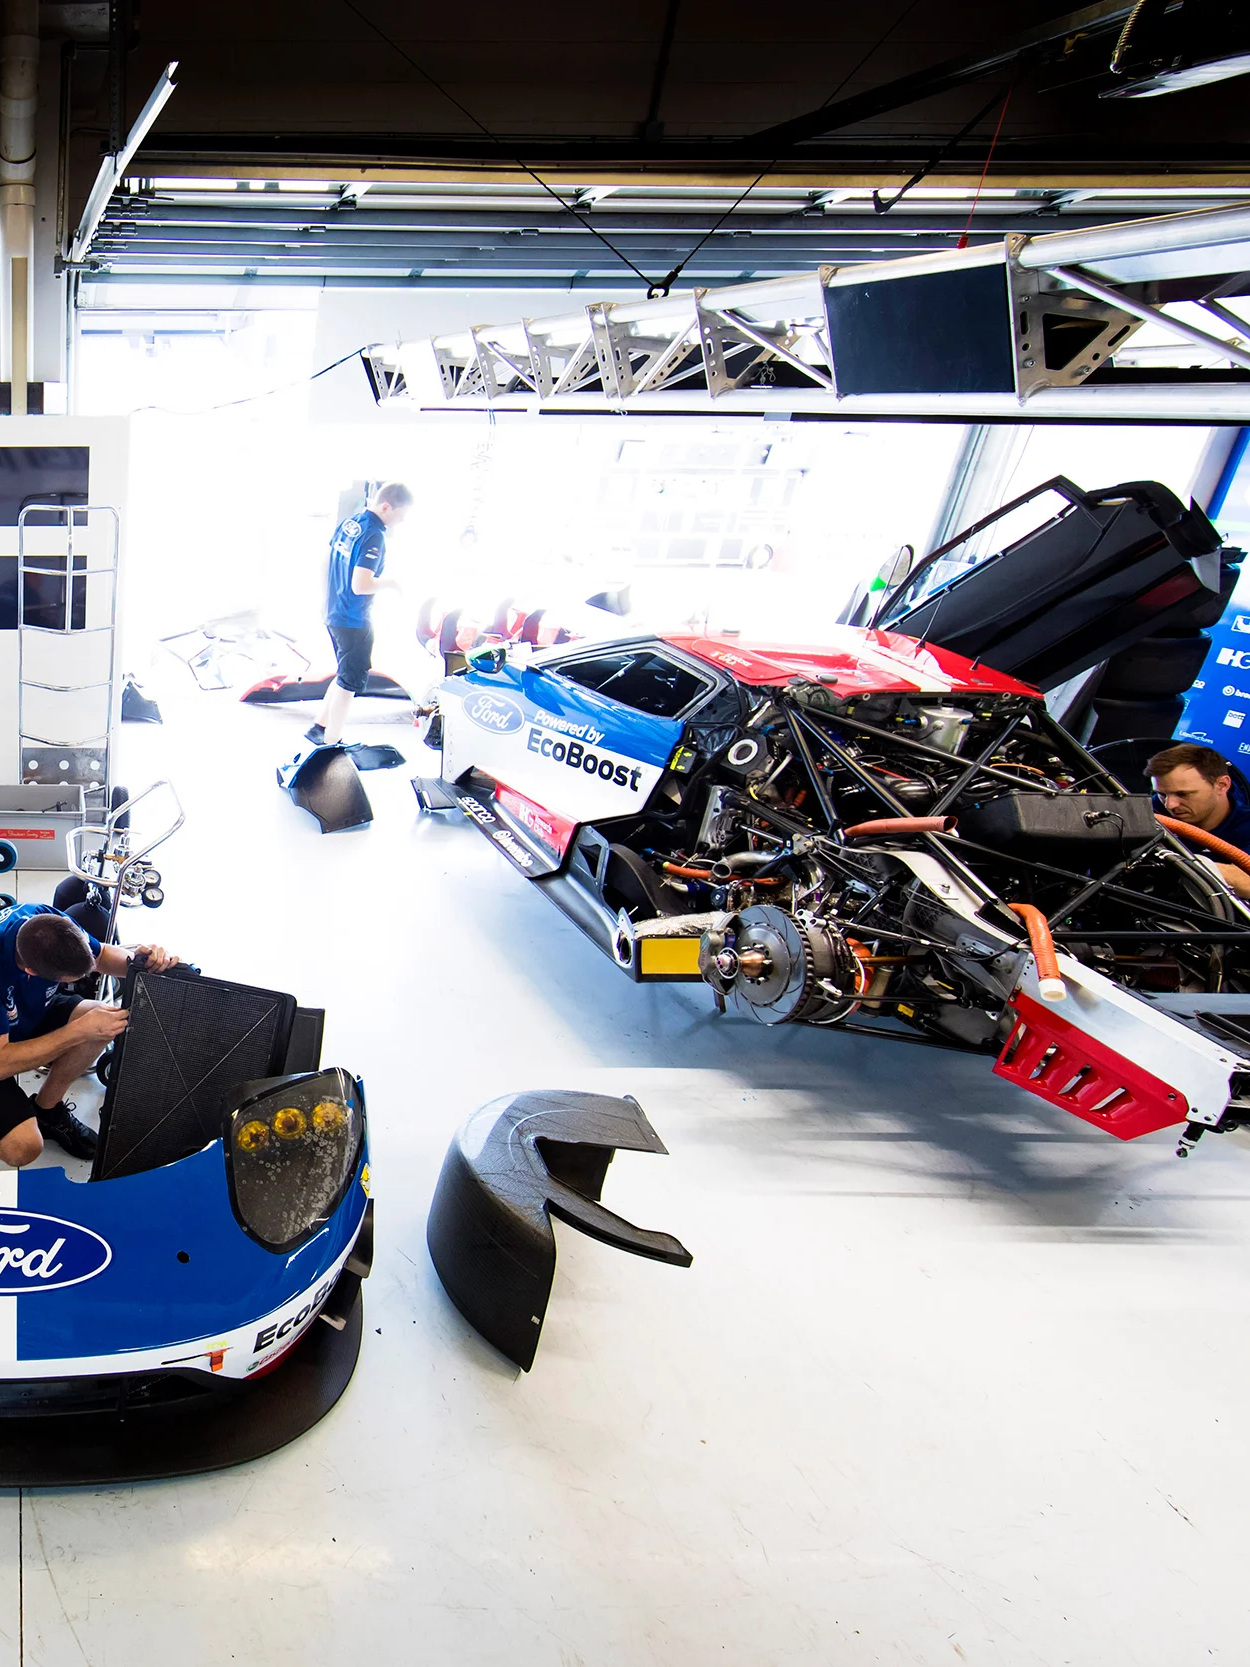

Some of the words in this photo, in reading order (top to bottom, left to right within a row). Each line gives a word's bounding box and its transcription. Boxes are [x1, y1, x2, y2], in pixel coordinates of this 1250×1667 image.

[472, 695, 513, 729] Ford
[533, 709, 588, 738] Powered
[585, 725, 605, 746] by
[527, 727, 642, 792] EcoBoost
